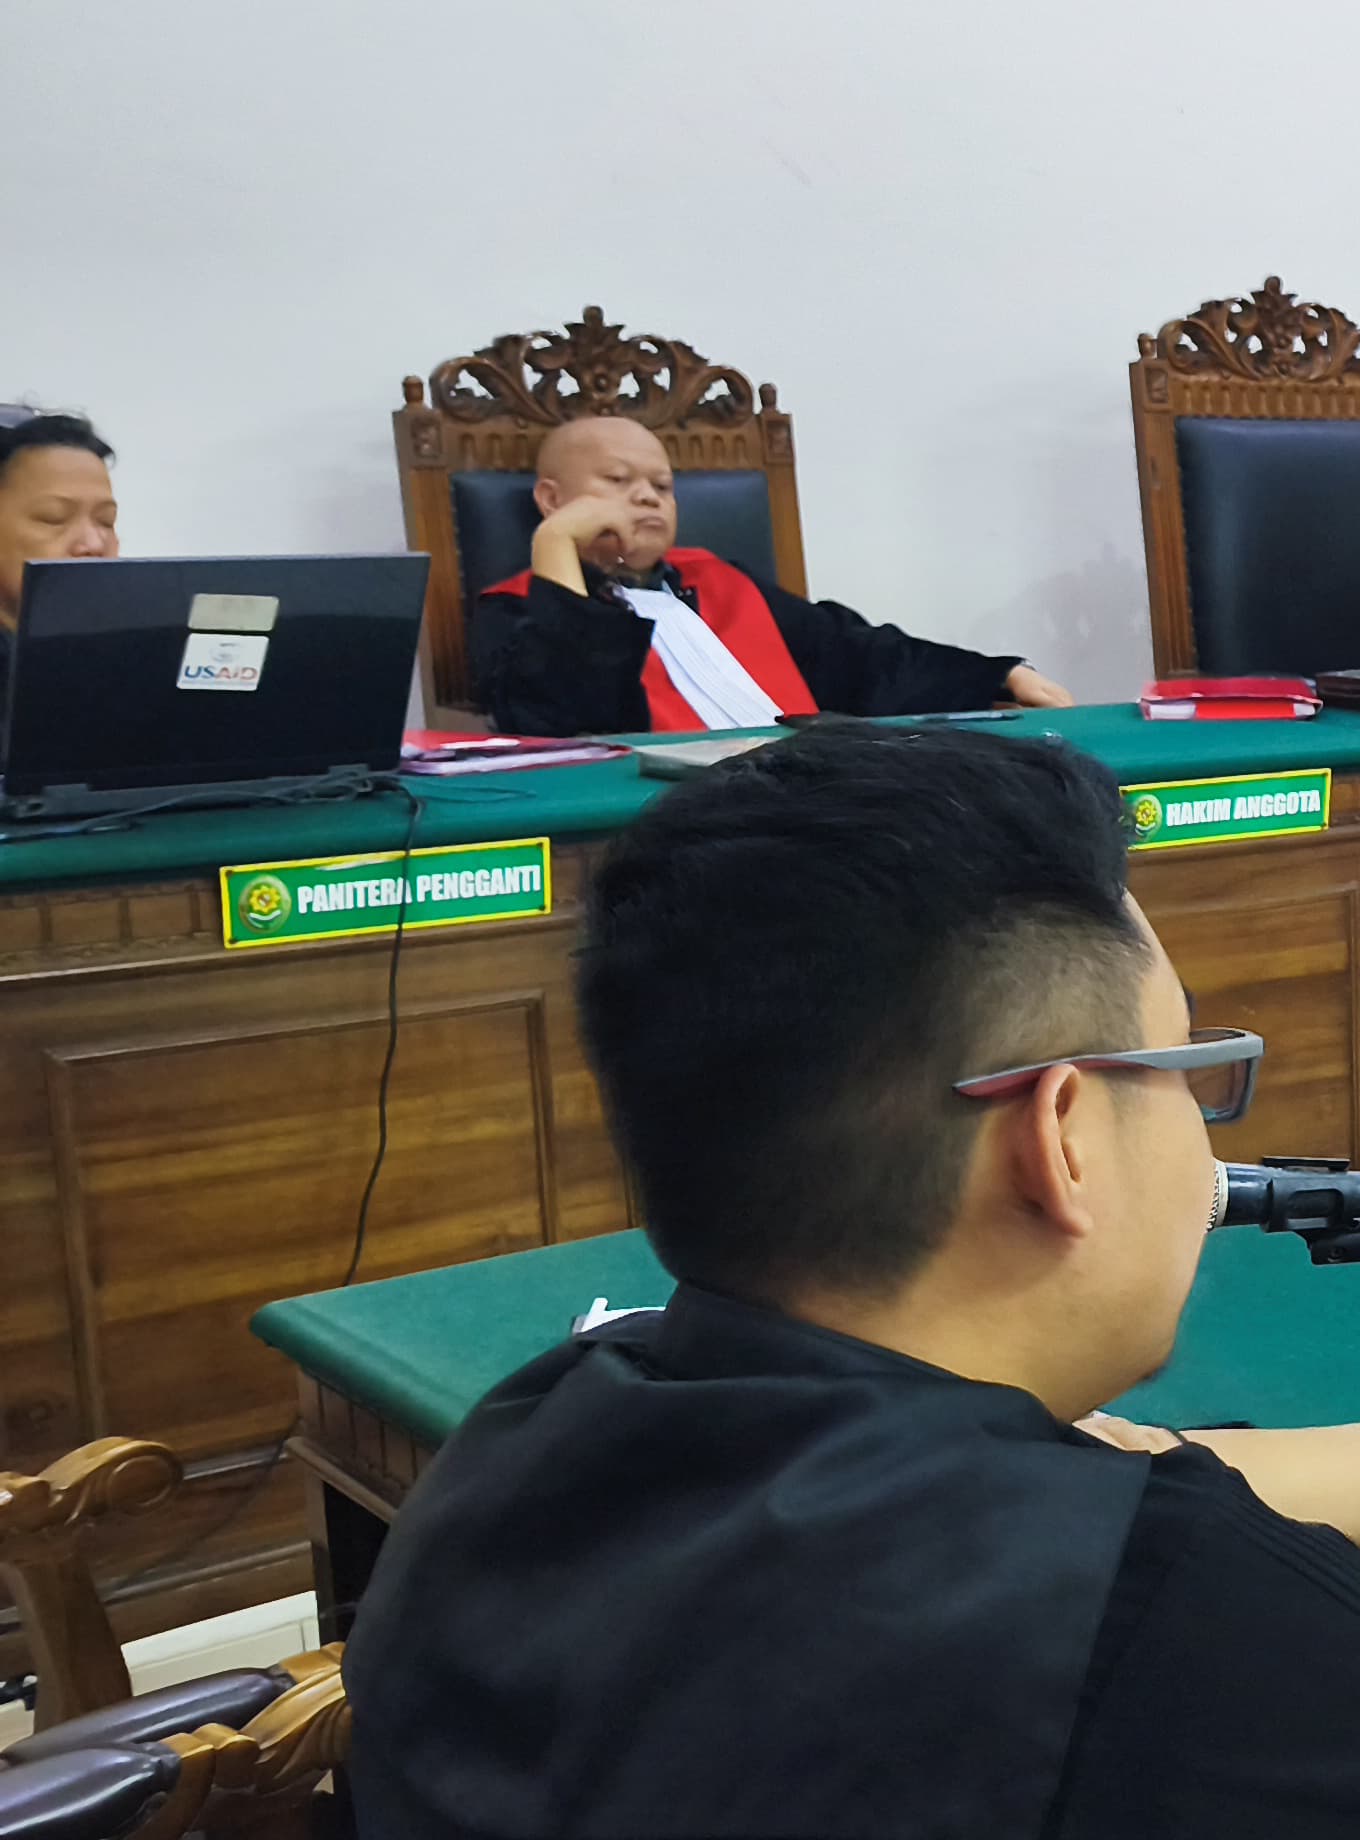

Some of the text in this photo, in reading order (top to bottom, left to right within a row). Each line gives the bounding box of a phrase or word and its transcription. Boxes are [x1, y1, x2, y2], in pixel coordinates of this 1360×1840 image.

[184, 665, 258, 680] USAID
[1166, 790, 1321, 827] HAKIM ANGGOTA
[298, 865, 541, 914] PANITERA PENGGANTI
